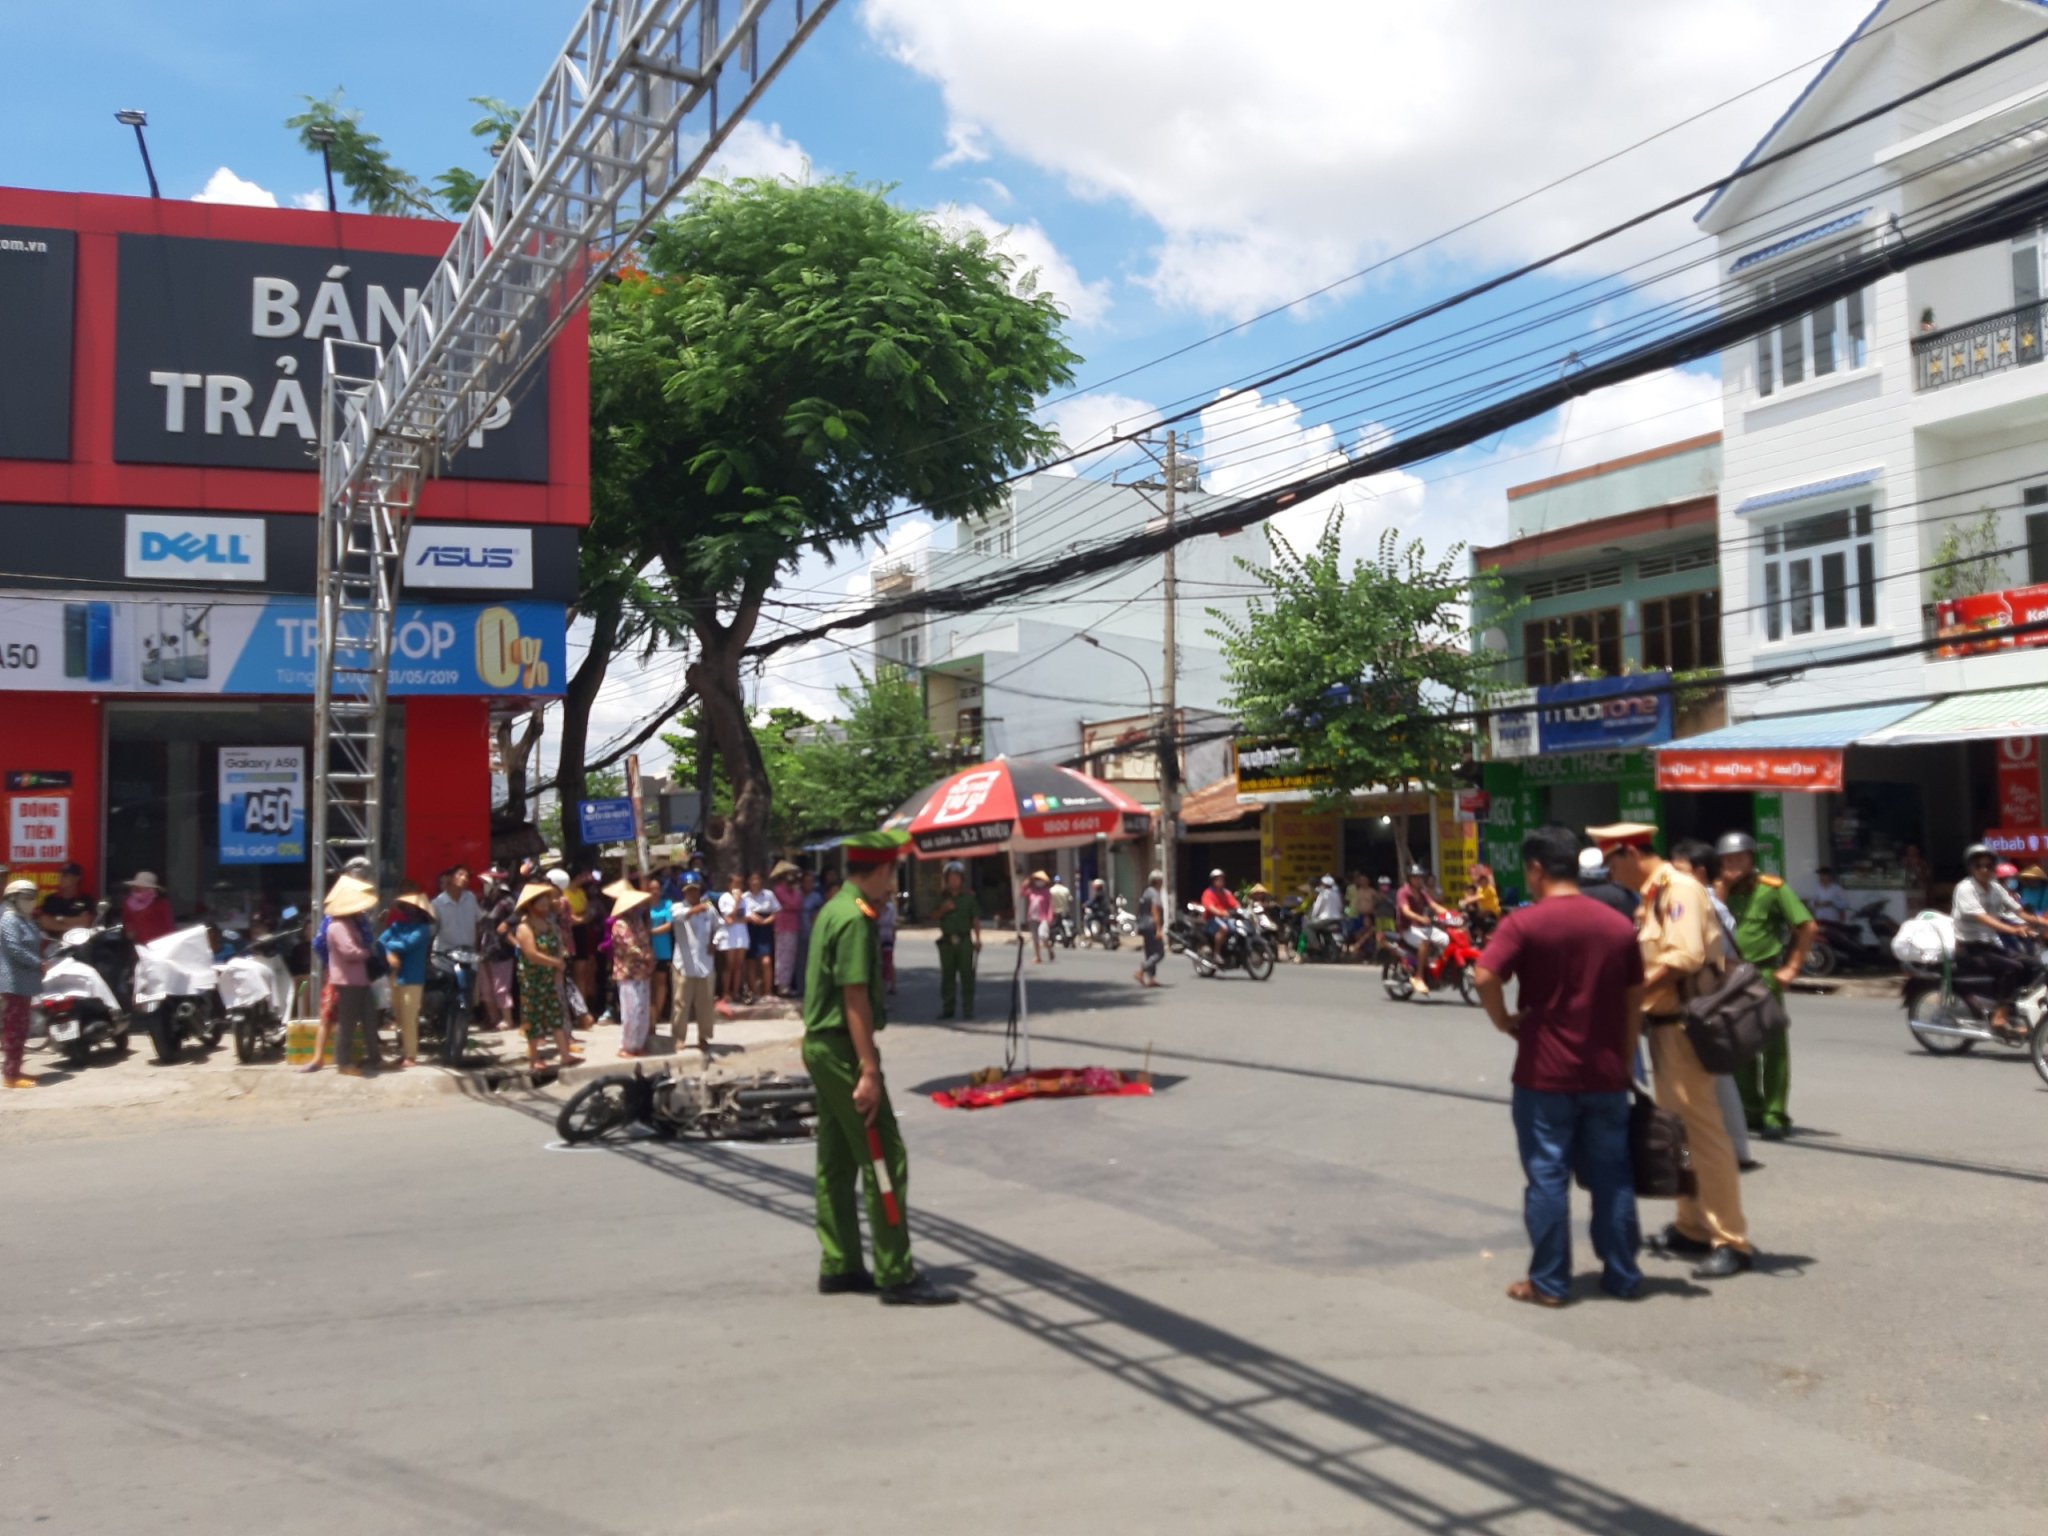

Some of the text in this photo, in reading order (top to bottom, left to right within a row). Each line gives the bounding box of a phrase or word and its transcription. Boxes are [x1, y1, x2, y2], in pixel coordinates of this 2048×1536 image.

[0, 240, 47, 252] om.vn
[251, 265, 419, 343] BÁN
[150, 356, 318, 440] TRẢ
[141, 532, 250, 564] DELL
[416, 546, 514, 568] ASUS
[384, 610, 455, 659] ÓP
[476, 607, 549, 689] 0%
[225, 758, 297, 771] Galaxy A50
[245, 791, 292, 833] A50
